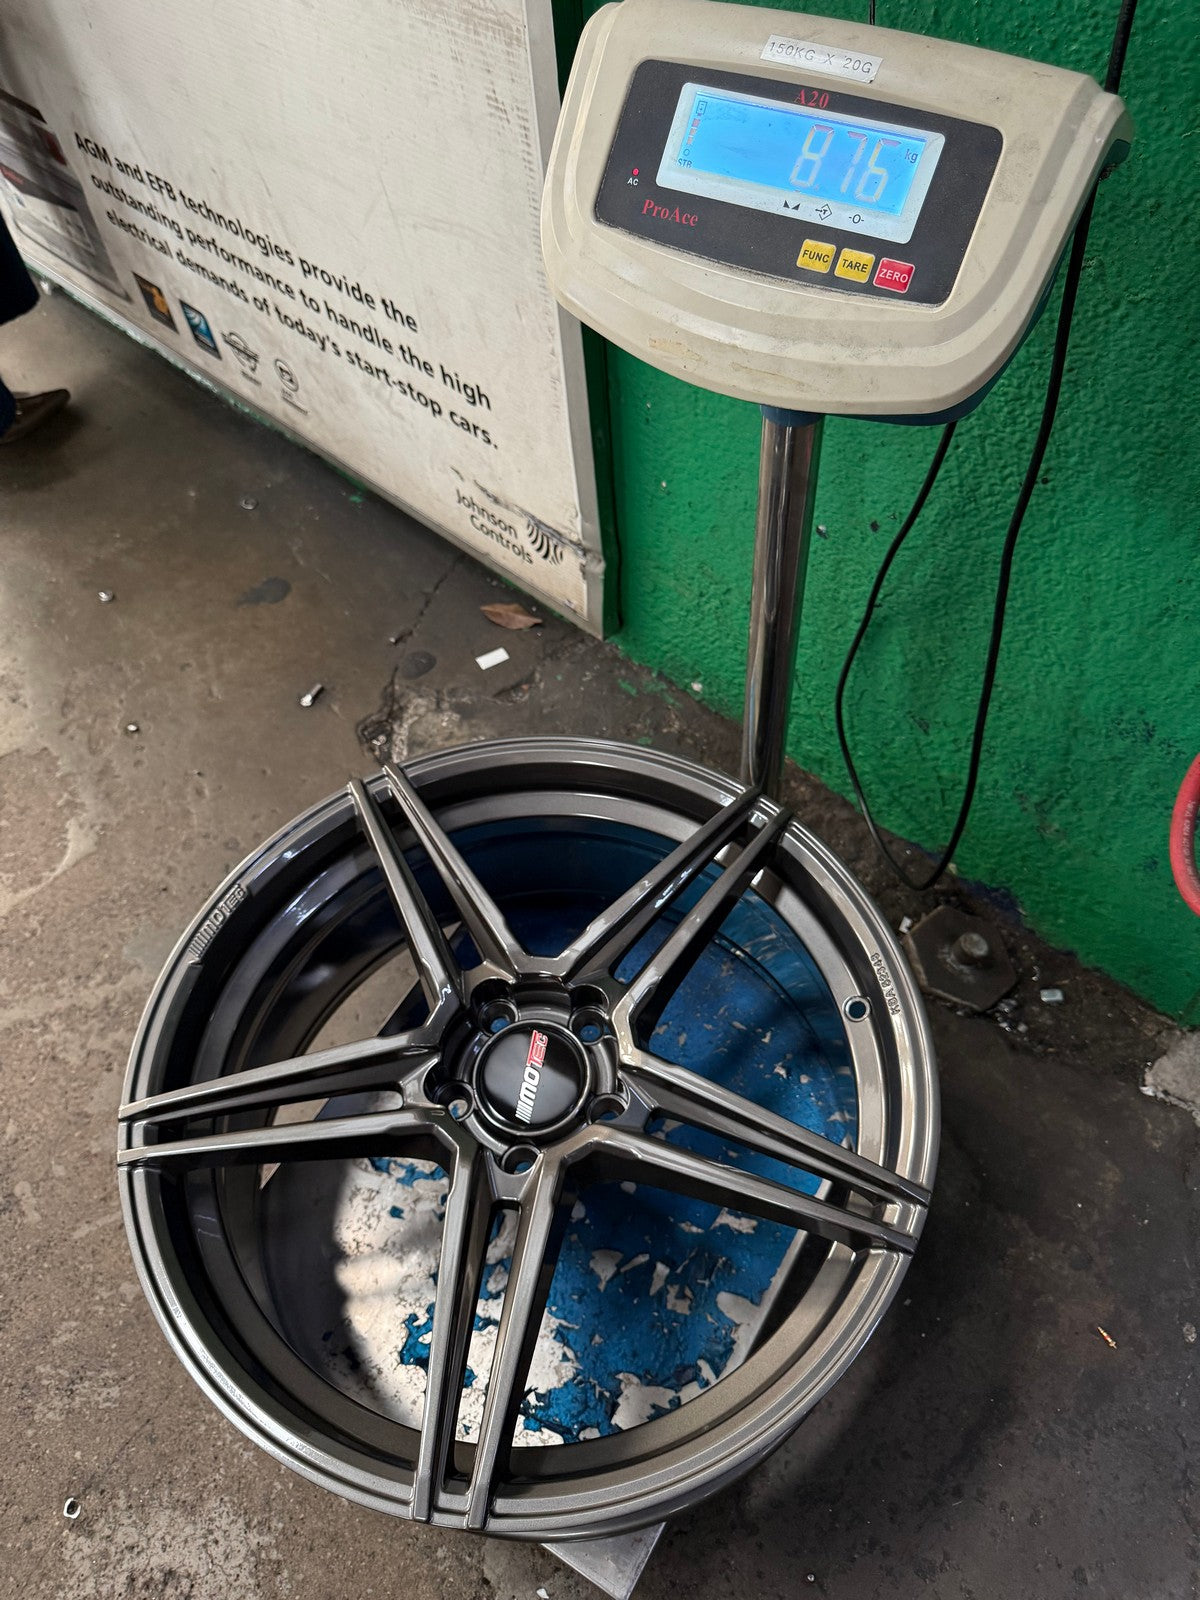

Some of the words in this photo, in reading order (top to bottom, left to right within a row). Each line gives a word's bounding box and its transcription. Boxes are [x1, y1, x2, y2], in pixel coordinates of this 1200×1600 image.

[769, 41, 816, 61] 150KG
[822, 53, 836, 65] X
[843, 56, 873, 74] 20G
[794, 89, 830, 109] A20
[904, 149, 918, 163] kg
[627, 177, 639, 186] AC
[642, 199, 698, 227] ProAce
[74, 132, 113, 167] AGM
[114, 156, 145, 185] and
[145, 171, 178, 202] EFB
[179, 190, 295, 266] technologies
[299, 258, 376, 310] provide
[381, 298, 418, 333] the
[802, 249, 830, 263] FUNC
[842, 258, 868, 273] TARE
[879, 268, 909, 283] ZERO
[91, 174, 184, 240] outstanding
[185, 227, 296, 300] performance
[299, 289, 321, 313] to
[323, 300, 394, 355] handle
[399, 345, 435, 378] the
[440, 364, 492, 411] high
[106, 210, 174, 259] electrical
[176, 250, 249, 303] demands
[253, 296, 271, 317] of
[274, 304, 342, 357] today's
[346, 349, 442, 417] start-stop
[449, 409, 498, 450] cars.
[456, 489, 518, 539] Johnson
[470, 514, 533, 564] Controls
[885, 987, 900, 1015] KBA
